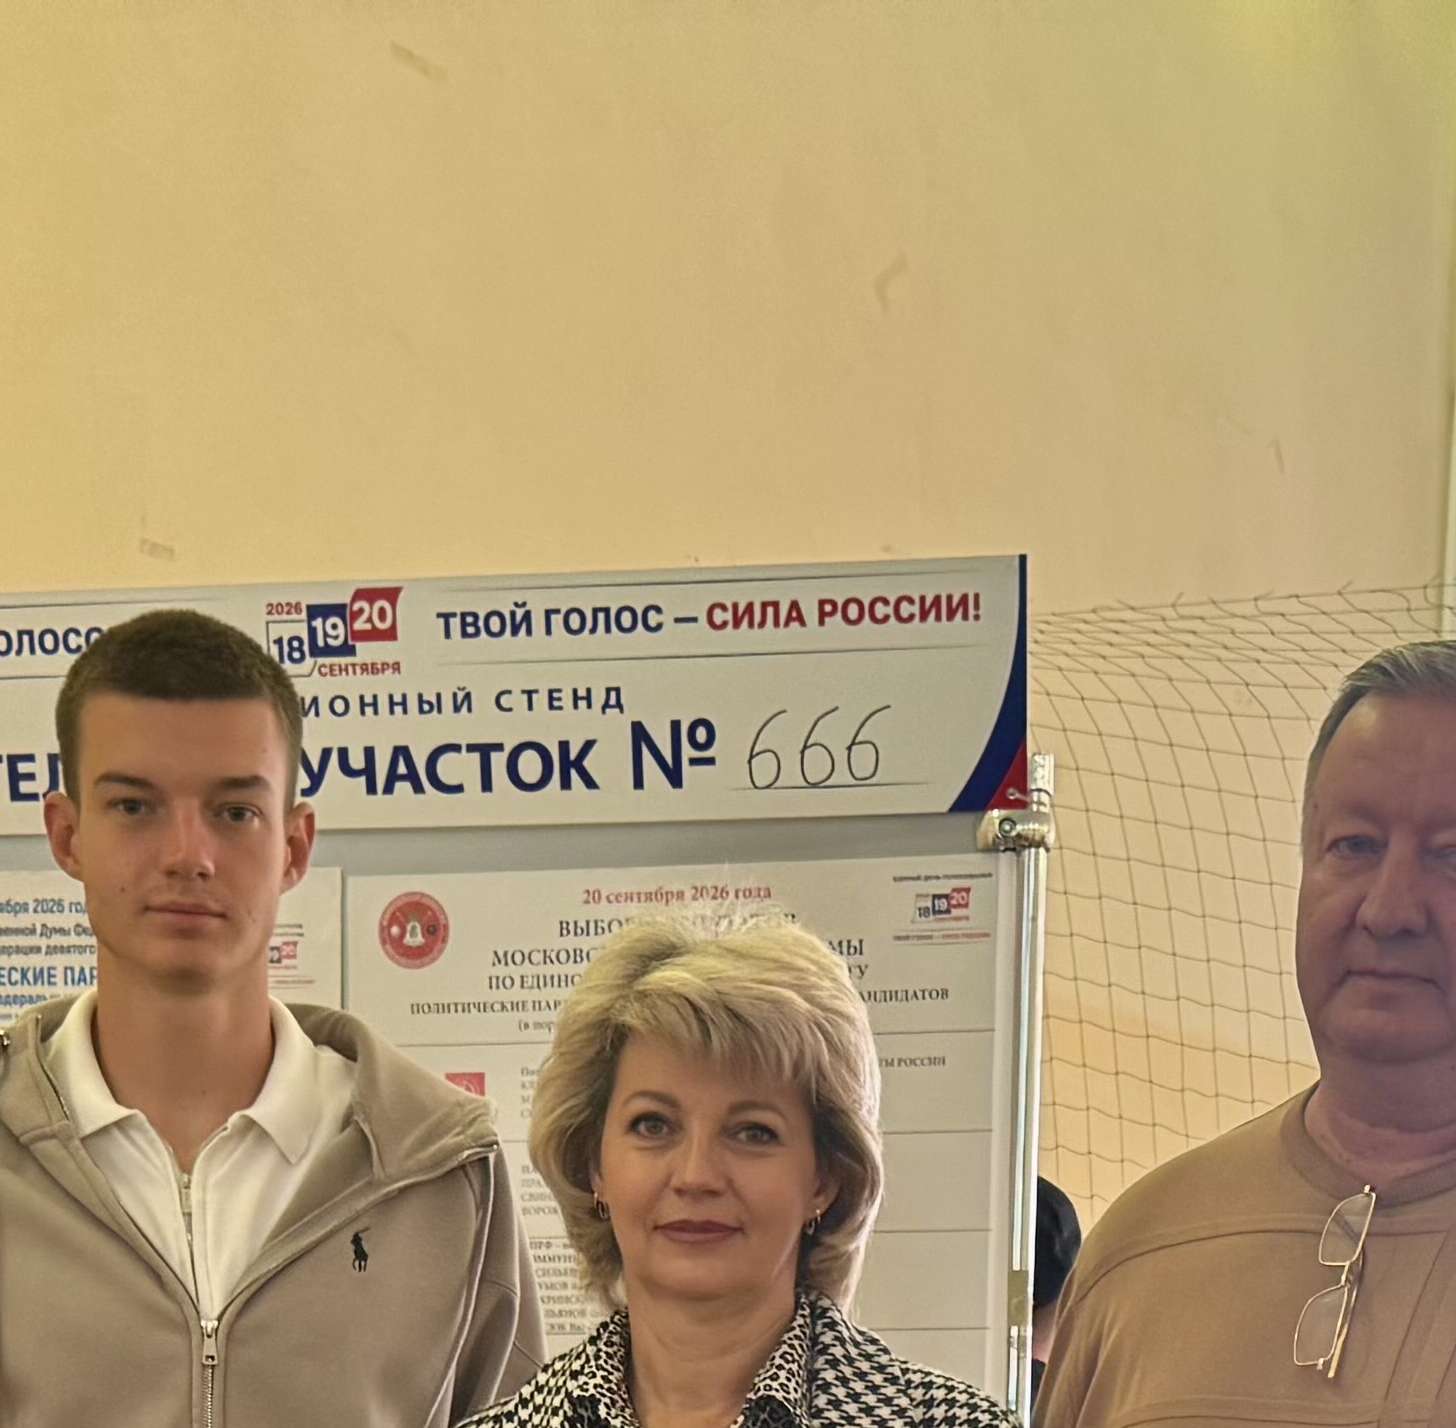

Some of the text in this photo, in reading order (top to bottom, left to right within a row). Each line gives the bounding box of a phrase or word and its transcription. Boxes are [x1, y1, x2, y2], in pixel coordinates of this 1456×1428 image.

[266, 602, 303, 616] 2026
[436, 602, 533, 639] ТВОЙ
[544, 605, 664, 637] ГОЛОС
[706, 600, 807, 632] СИЛА
[818, 592, 982, 628] РОССИИ!
[273, 600, 393, 665] 18 19 20
[318, 662, 401, 677] СЕНТЯБРЯ
[302, 686, 624, 718] ИОННЫЙ СТЕНД
[301, 739, 600, 797] УЧАСТОК
[631, 717, 716, 790] №
[747, 705, 891, 789] 666
[33, 898, 65, 914] 2026
[583, 884, 771, 907] 20 сентября 2026 года
[559, 918, 629, 938] ВЫБО
[492, 948, 594, 967] МОСКОВС
[64, 966, 98, 987] ПАР
[488, 974, 583, 991] ПО ЕДИНО
[410, 988, 949, 1016] ПОЛИТИЧЕСКИЕ ПАР АНДИДАТОВ
